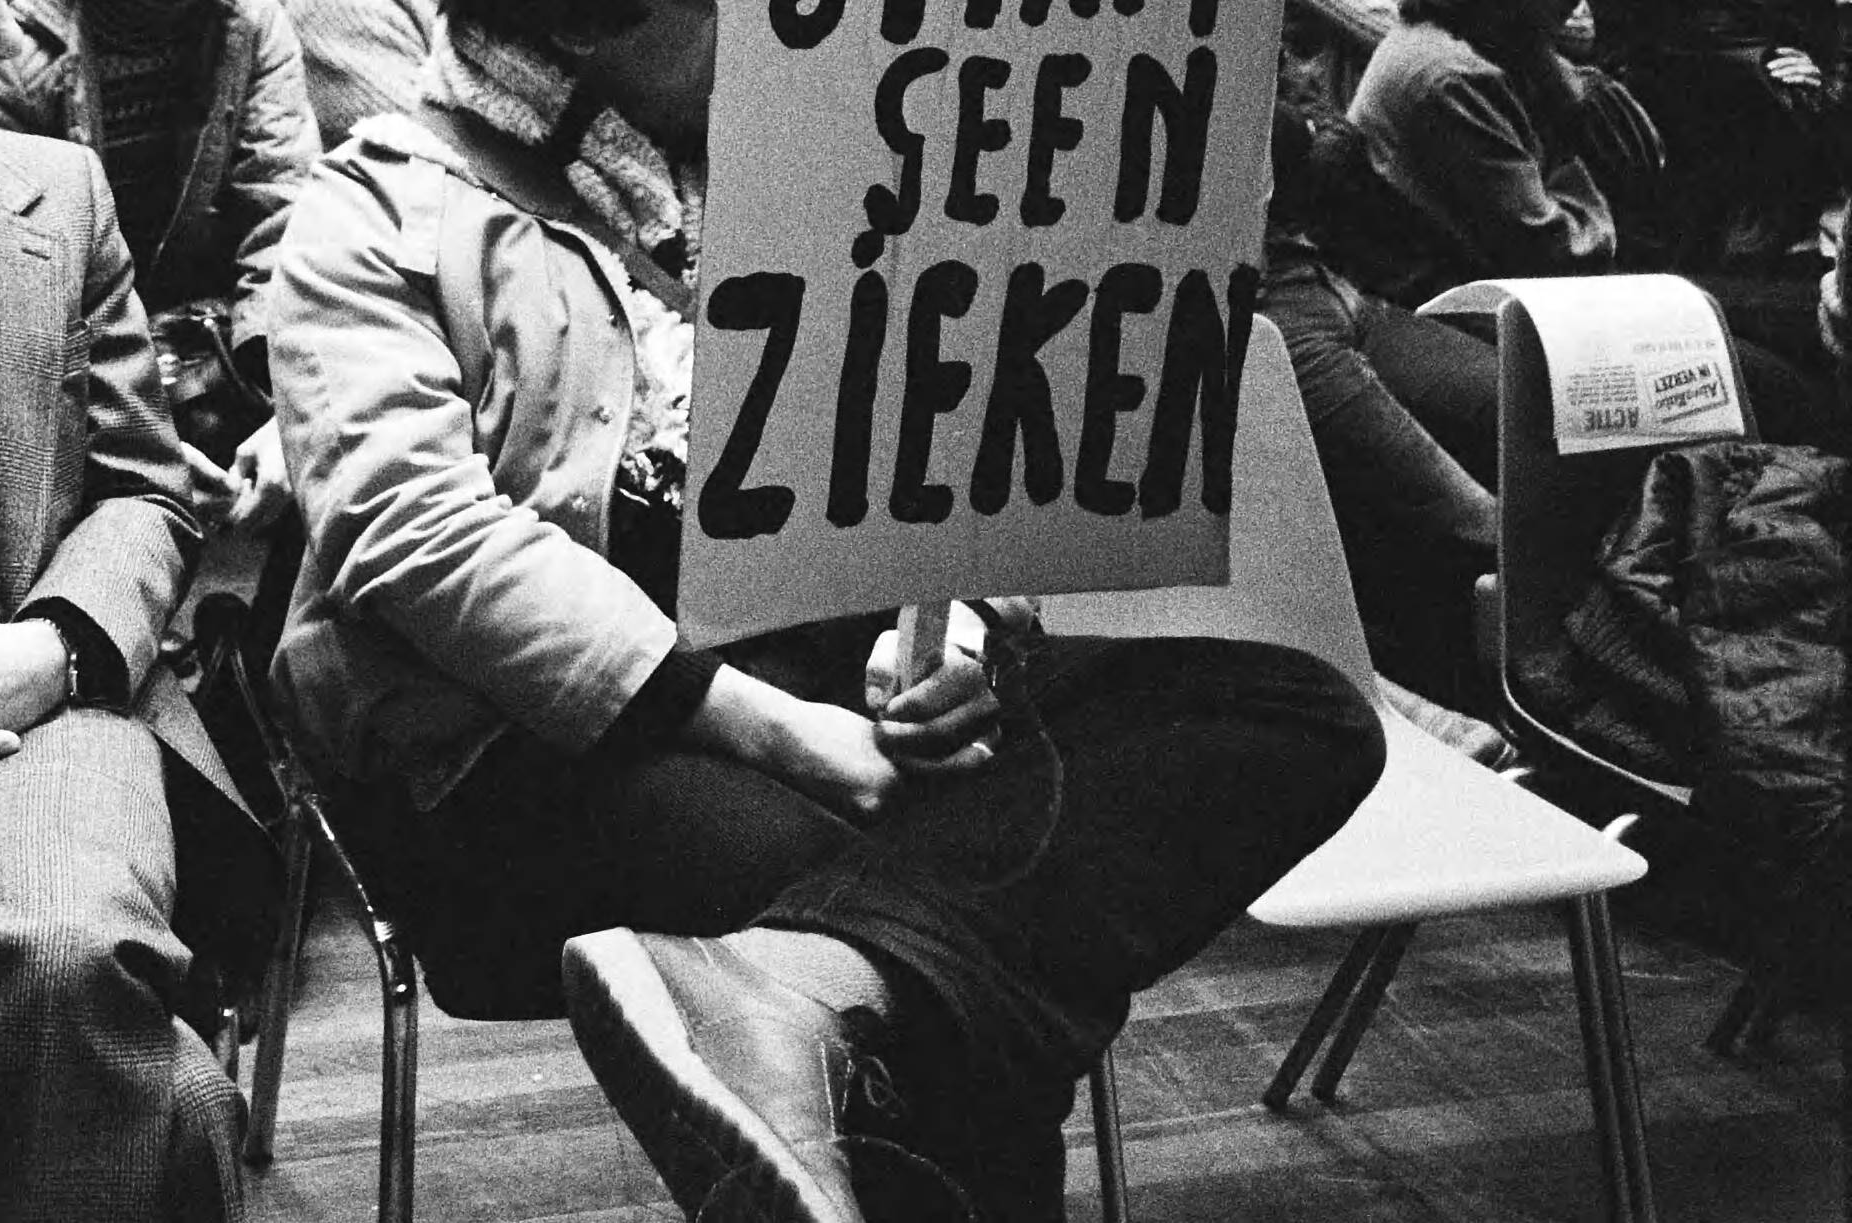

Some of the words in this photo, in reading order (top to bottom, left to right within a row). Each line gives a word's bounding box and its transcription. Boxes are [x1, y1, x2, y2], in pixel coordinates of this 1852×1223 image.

[862, 45, 1218, 236] GEEN
[1654, 369, 1697, 393] VERZET
[1584, 406, 1640, 432] ACTIE
